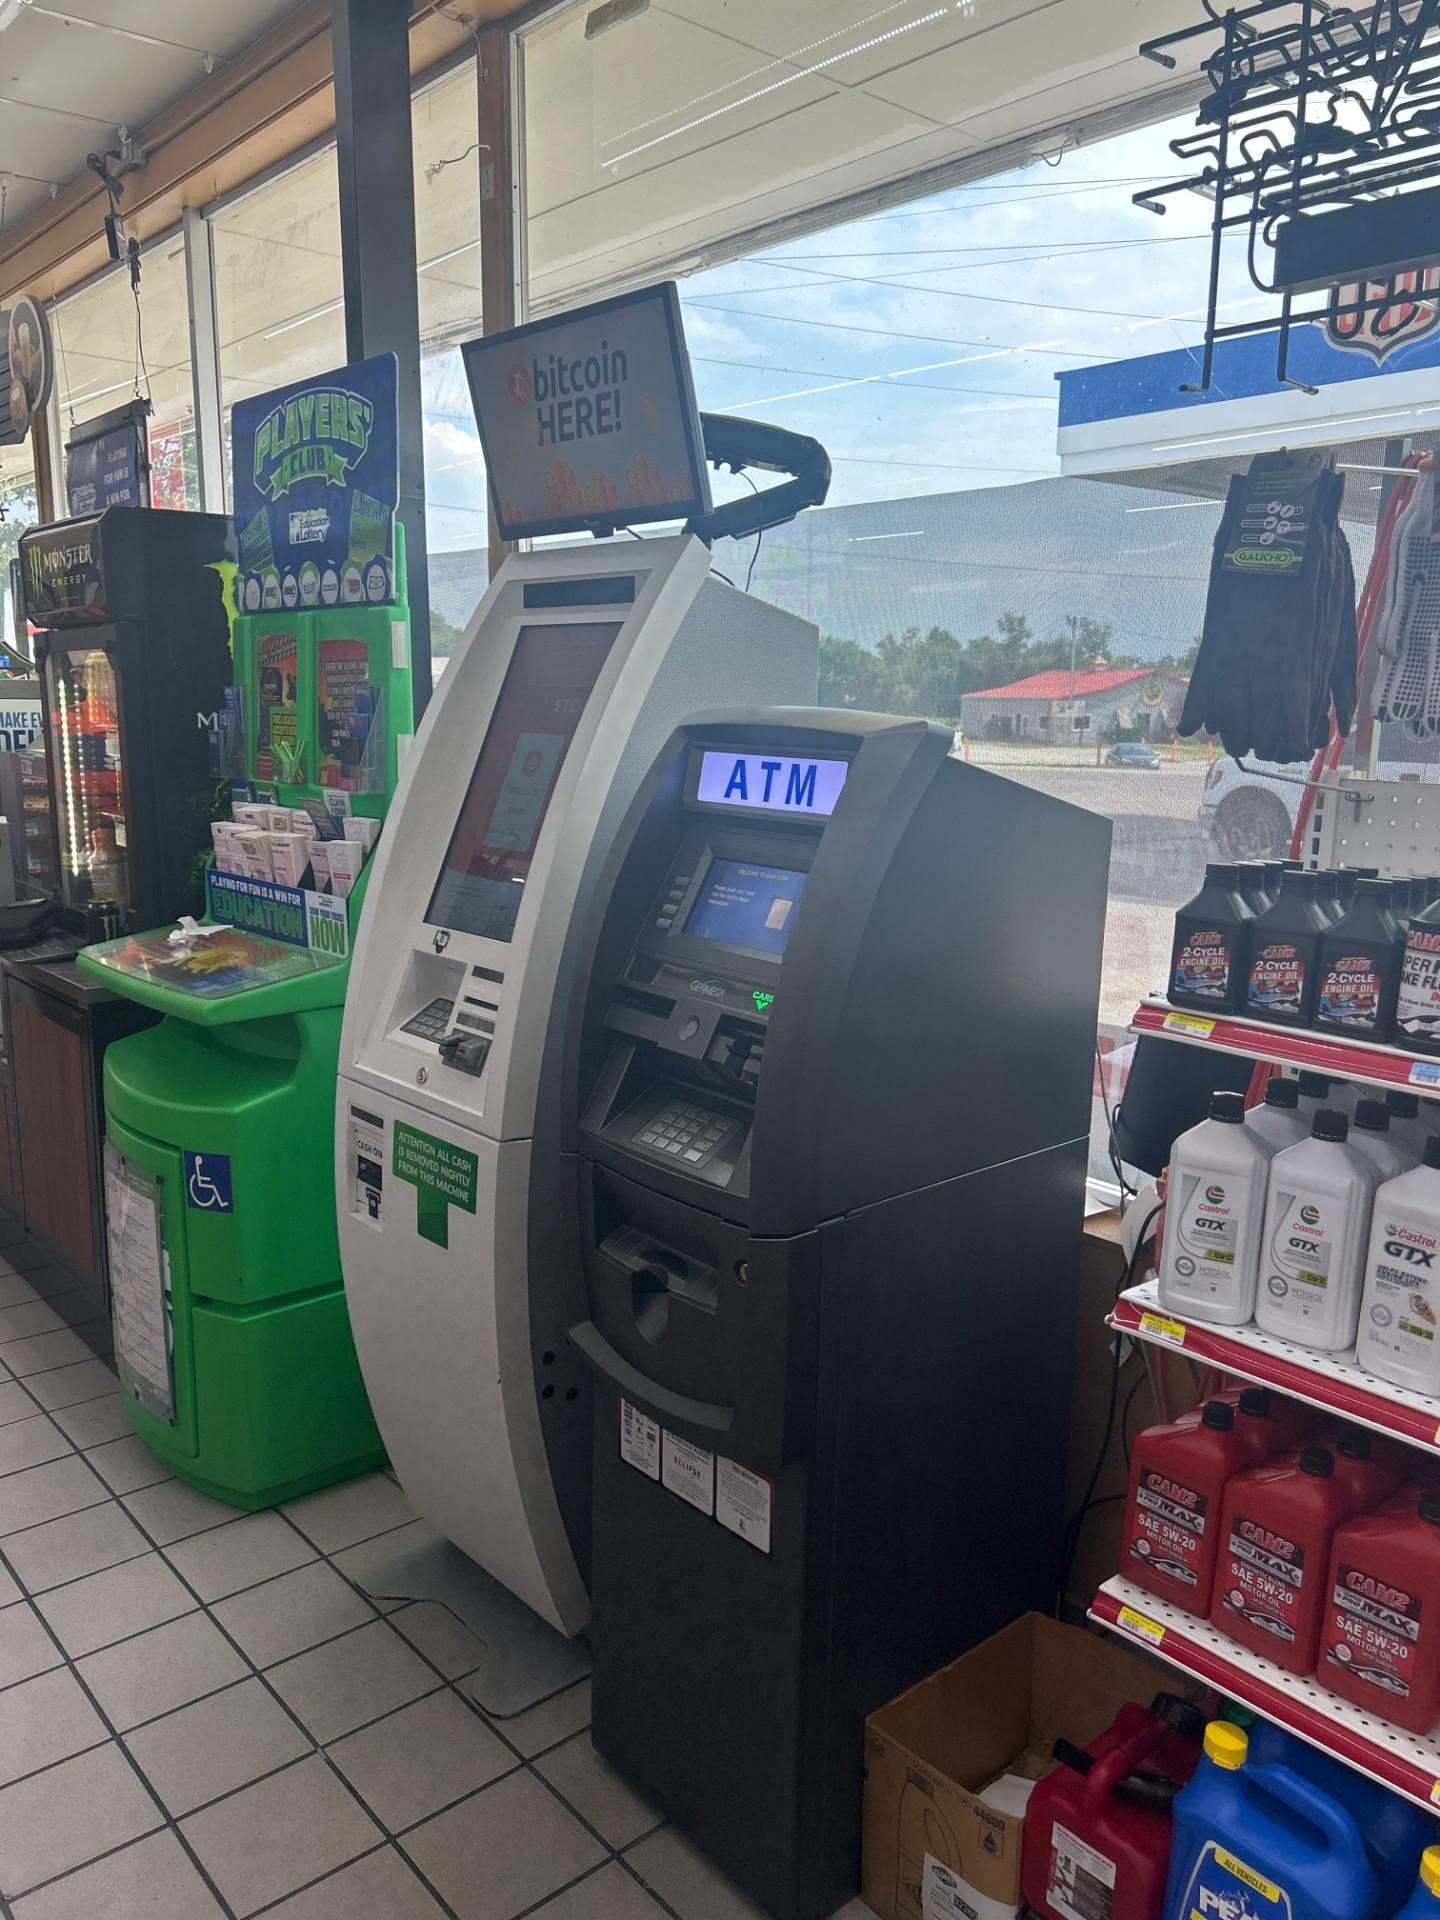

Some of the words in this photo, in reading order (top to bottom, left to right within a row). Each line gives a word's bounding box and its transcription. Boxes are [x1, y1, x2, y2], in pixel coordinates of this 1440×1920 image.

[533, 340, 628, 402] bitcoin
[537, 390, 623, 446] HERE!
[290, 447, 327, 476] CLUB
[300, 515, 330, 529] Education
[301, 527, 327, 542] Lottery
[44, 544, 93, 573] MONSTER
[1240, 552, 1288, 563] GAUCHO
[52, 574, 87, 588] ENERGY
[724, 759, 818, 808] ATM
[329, 798, 345, 807] CLAIM
[211, 875, 236, 890] PLAYING
[236, 880, 248, 893] FOR
[248, 883, 260, 897] FUN
[261, 886, 268, 898] IS
[268, 888, 274, 900] A
[274, 890, 287, 903] WIN
[288, 892, 301, 906] FOR
[213, 888, 304, 940] EDUCATION
[310, 915, 345, 955] NOW
[1181, 957, 1209, 967] ENGINE
[1213, 957, 1225, 965] OIL
[1183, 946, 1225, 957] 2-CYCLE
[1256, 960, 1299, 971] 2-CYCLE
[1405, 955, 1432, 974] PER
[1253, 971, 1282, 980] ENGINE
[1285, 971, 1299, 980] OIL
[1325, 984, 1357, 993] ENGINE
[1360, 984, 1375, 993] OIL
[1328, 973, 1376, 984] 2-CYCLE
[357, 1140, 372, 1152] CASH
[398, 1131, 436, 1156] ATTENTION
[437, 1148, 450, 1163] ALL
[451, 1155, 472, 1173] CASH
[398, 1145, 404, 1156] IS
[405, 1149, 439, 1173] REMOVED
[440, 1164, 471, 1187] NIGHTLY
[398, 1160, 418, 1178] FROM
[419, 1169, 435, 1185] THIS
[436, 1177, 469, 1202] MACHINE
[1198, 1203, 1231, 1215] Castrol
[1195, 1217, 1226, 1231] GTX
[1292, 1222, 1325, 1237] Castrol
[1289, 1237, 1320, 1253] GTX
[1398, 1229, 1437, 1248] Castrol
[1384, 1241, 1437, 1269] GTX
[1199, 1266, 1220, 1277] MOTOR
[673, 1455, 701, 1478] ECLIPSE
[1147, 1473, 1198, 1509] CAM2
[1159, 1498, 1199, 1529] MAX
[1138, 1513, 1160, 1533] SAE
[1162, 1526, 1196, 1551] 5W-20
[1146, 1529, 1172, 1549] MOTOR
[1173, 1543, 1184, 1554] OIL
[1240, 1521, 1295, 1559] CAM2
[1253, 1548, 1296, 1582] MAX
[1231, 1562, 1254, 1584] SAE
[1257, 1578, 1293, 1605] 5W-20
[1240, 1580, 1267, 1600] MOTOR
[1268, 1595, 1280, 1608] OIL
[1346, 1571, 1410, 1612] CAM2
[1360, 1600, 1411, 1635] MAX
[1336, 1615, 1362, 1638] SAE
[1367, 1630, 1408, 1659] 5W-20
[1346, 1634, 1378, 1654] MOTOR
[1380, 1650, 1393, 1662] OIL
[1224, 1859, 1235, 1872] ALL
[1236, 1866, 1267, 1893] VEHICLES
